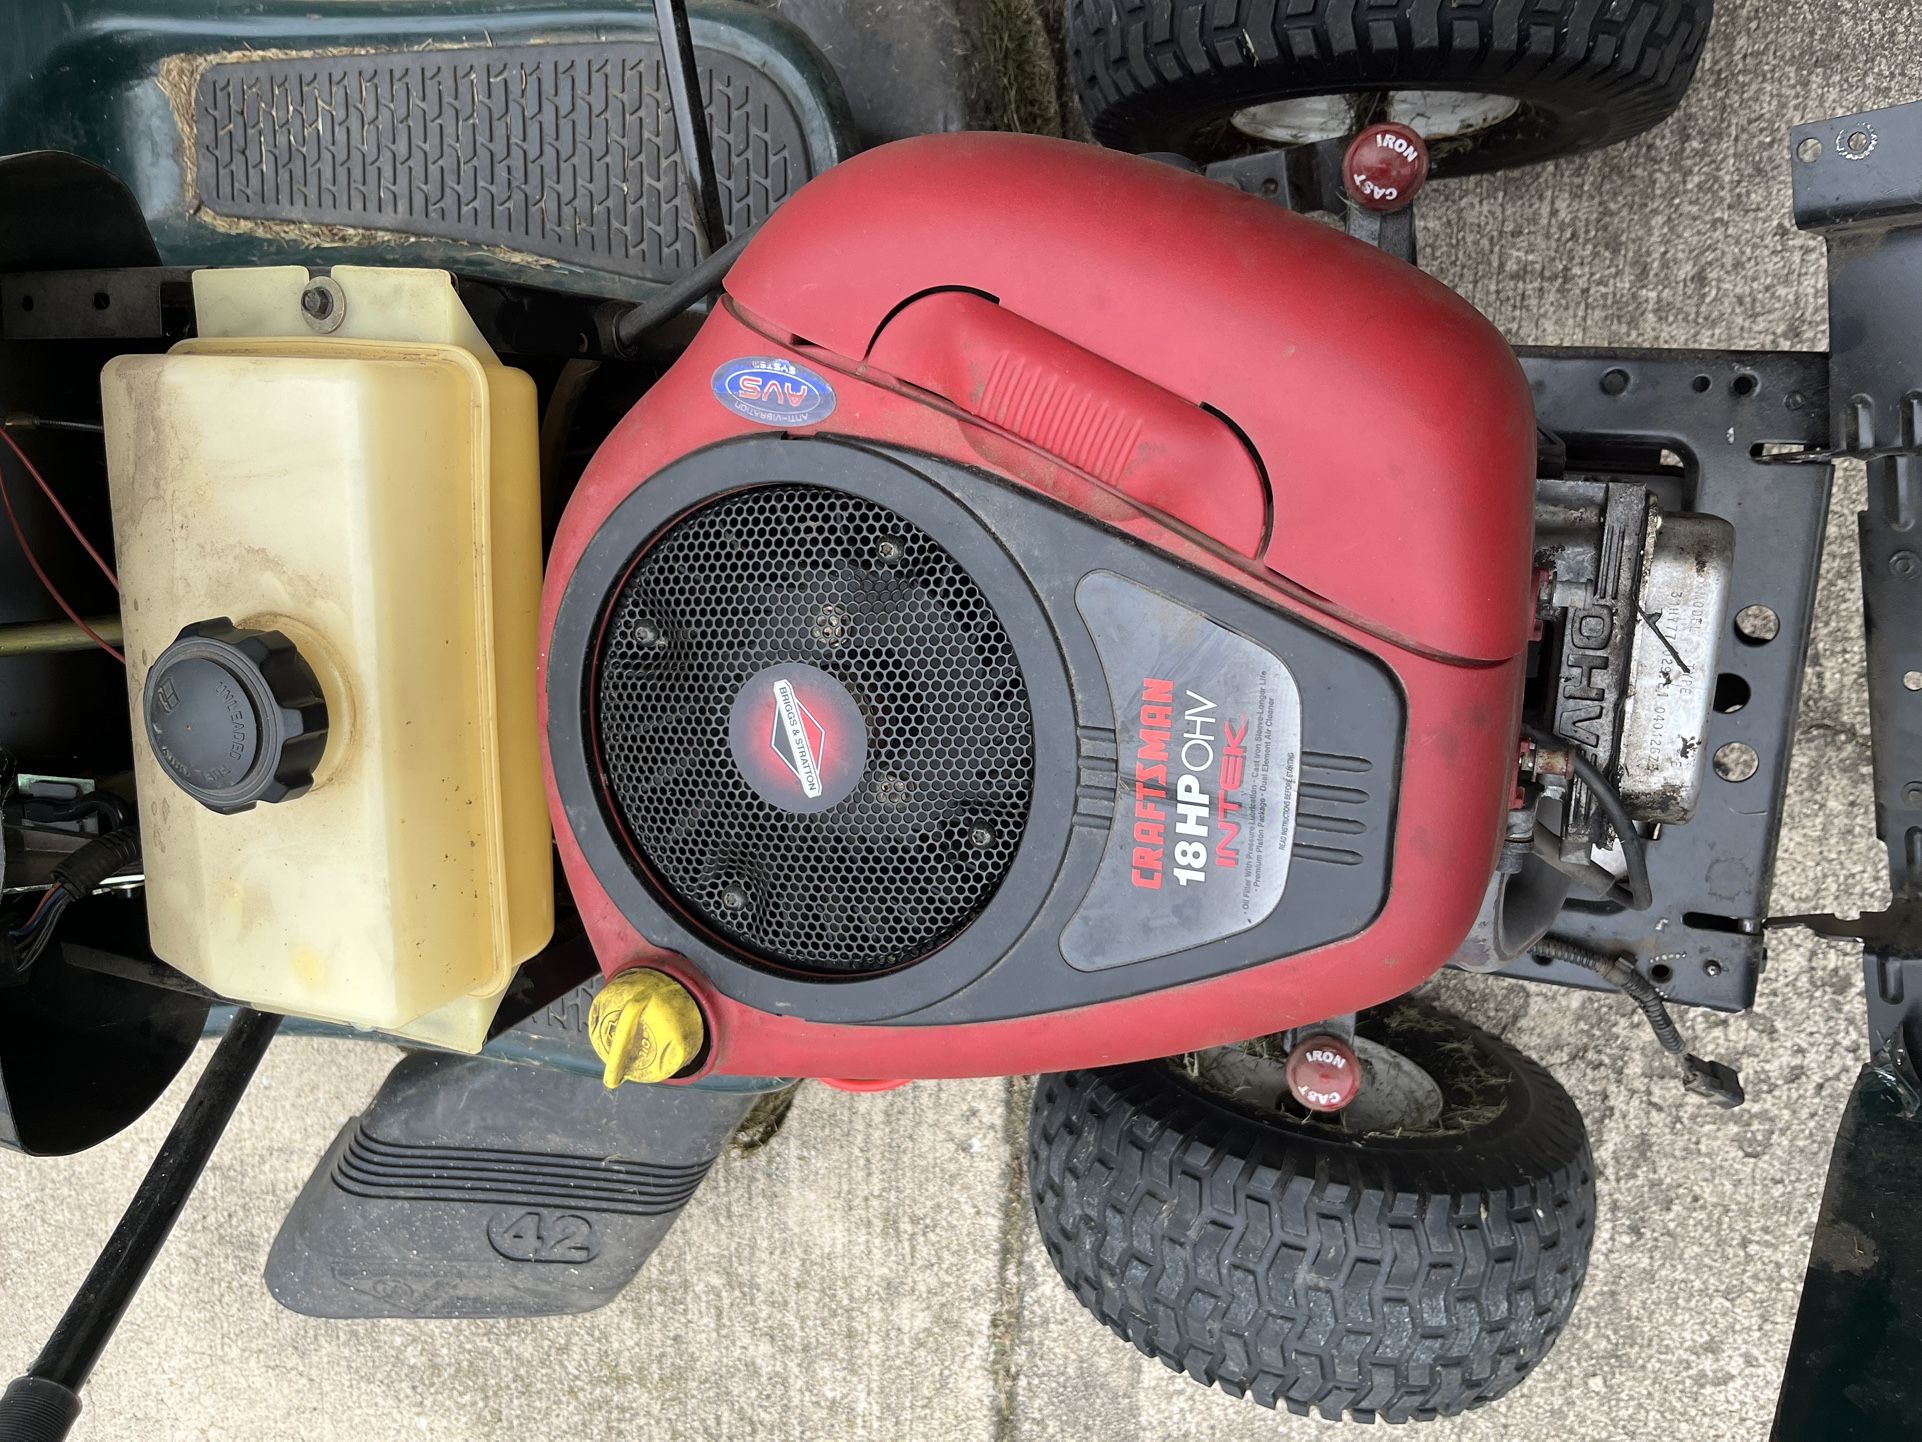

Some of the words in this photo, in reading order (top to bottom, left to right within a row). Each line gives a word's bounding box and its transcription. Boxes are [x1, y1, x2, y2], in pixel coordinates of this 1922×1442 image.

[1376, 134, 1418, 162] IRON
[1354, 174, 1397, 200] CAST
[739, 376, 808, 407] AVS
[1558, 605, 1613, 748] OHV
[215, 681, 245, 761] UNLEADED
[1266, 698, 1274, 726] Cleaner
[779, 687, 797, 726] BRIGGS
[795, 738, 816, 791] STRATTON
[1264, 729, 1272, 739] Air
[1251, 761, 1260, 777] Cast
[1262, 742, 1271, 772] Element
[1131, 678, 1174, 890] CRAFTSMAN
[1215, 720, 1248, 868] INTEK
[1284, 779, 1293, 800] BEFORE
[1249, 785, 1257, 824] Lubrication
[1258, 798, 1266, 827] Package
[1281, 801, 1290, 835] INSTRUCTIONS
[1247, 826, 1255, 859] Pressure
[1256, 830, 1264, 852] Piston
[1279, 836, 1287, 850] READ
[1244, 861, 1252, 877] With
[1254, 855, 1262, 887] Premium
[1241, 879, 1250, 897] Filter
[1242, 899, 1250, 909] Oil
[1306, 1050, 1346, 1069] IRON
[1298, 1085, 1340, 1104] CAST
[502, 1212, 590, 1257] 42
